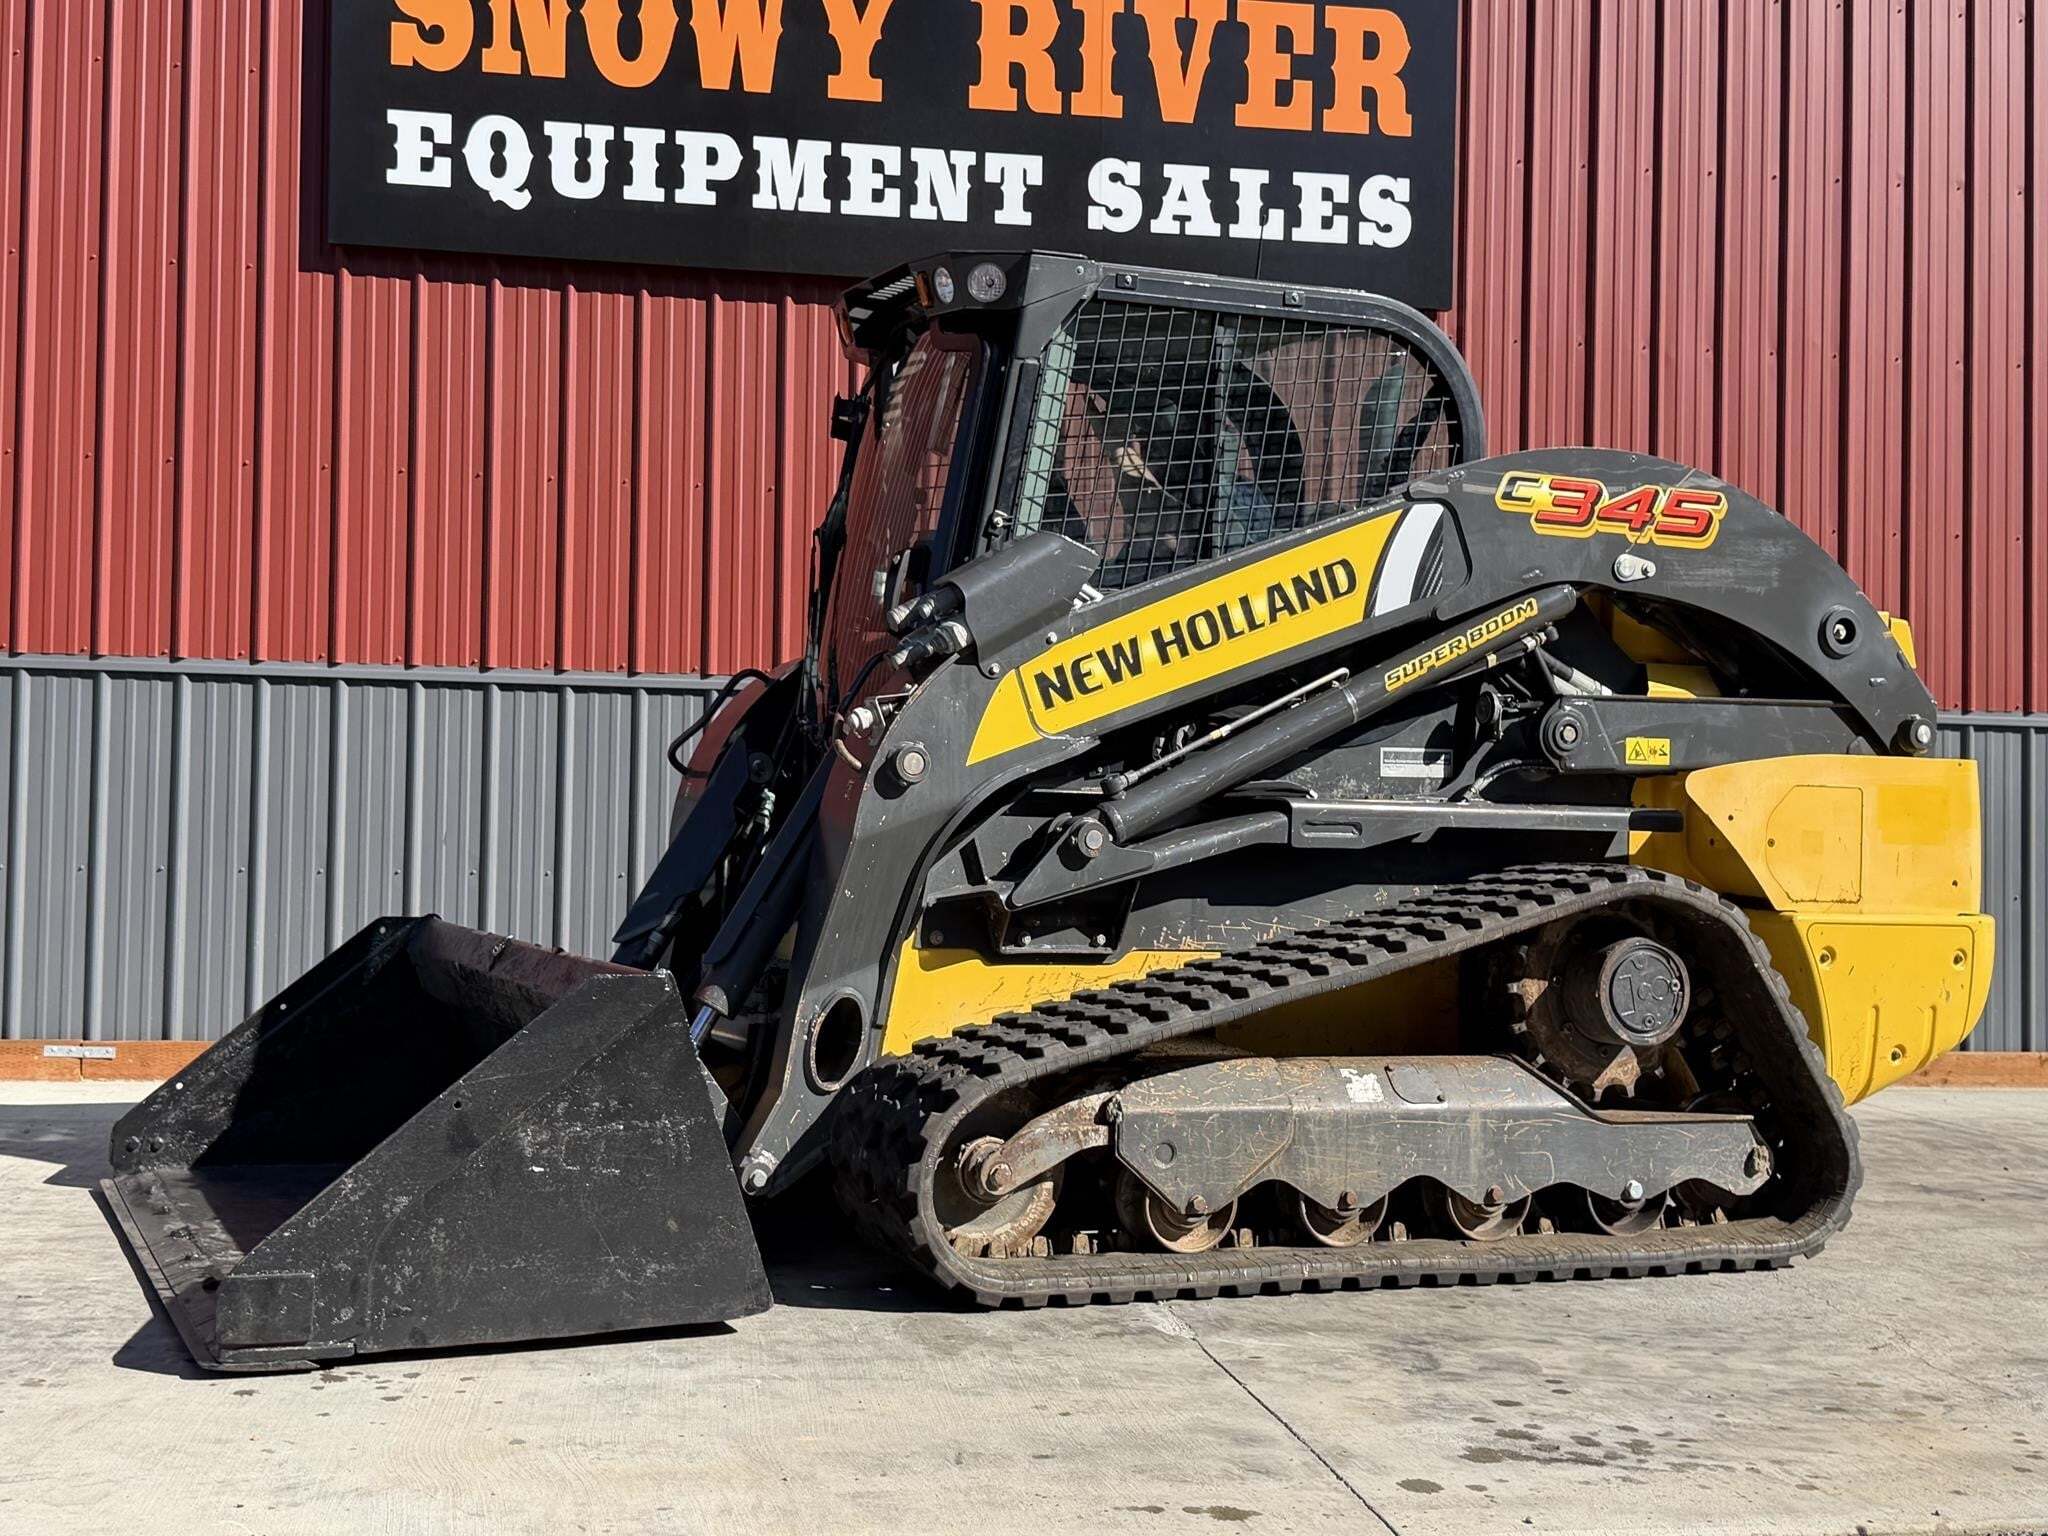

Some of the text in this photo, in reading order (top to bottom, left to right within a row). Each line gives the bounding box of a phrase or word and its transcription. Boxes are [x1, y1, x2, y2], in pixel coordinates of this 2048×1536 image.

[968, 0, 1412, 137] RIVER
[386, 109, 1412, 249] EQUIPMENT SALES
[1033, 557, 1358, 711] NEW HOLLAND
[1385, 598, 1538, 691] SUPER BOOM
